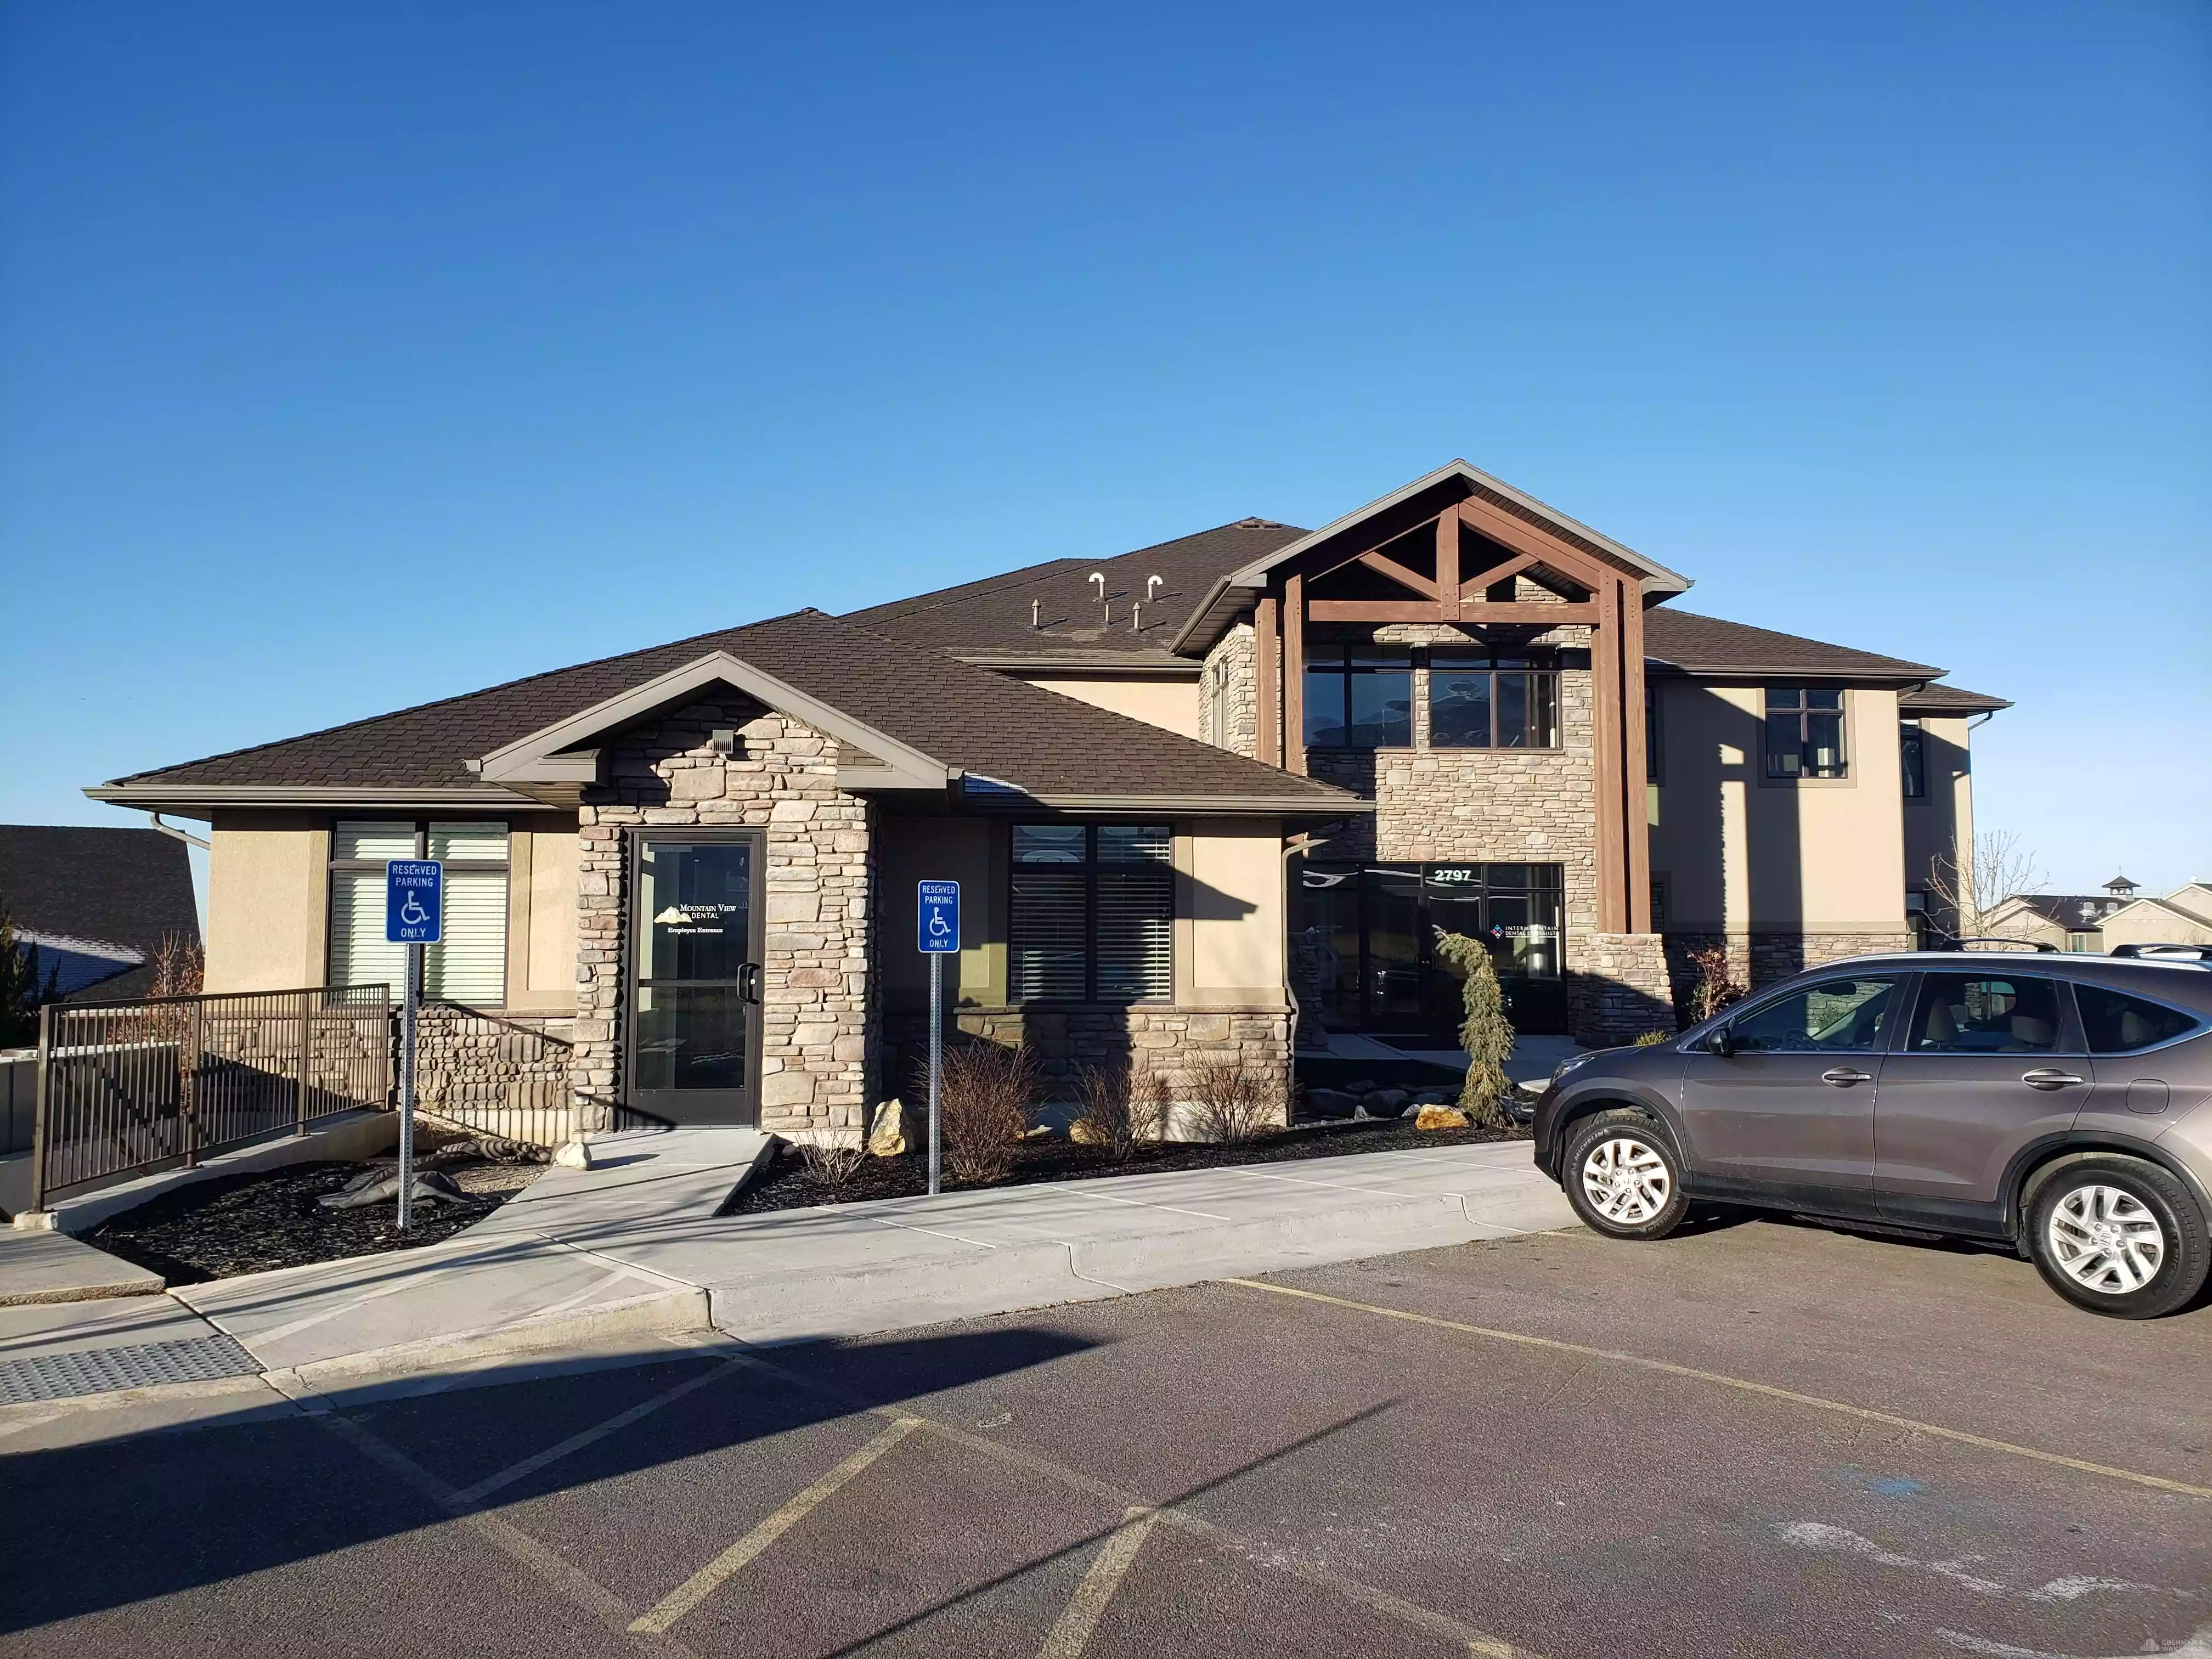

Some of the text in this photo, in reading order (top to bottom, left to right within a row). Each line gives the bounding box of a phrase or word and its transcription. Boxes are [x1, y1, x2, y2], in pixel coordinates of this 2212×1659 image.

[392, 865, 437, 875] RESERVED
[1435, 870, 1471, 881] 2797
[396, 877, 433, 887] PARKING
[922, 885, 956, 894] RESERVED
[924, 896, 953, 904] PARKING
[400, 928, 426, 938] ONLY
[929, 939, 949, 948] ONLY
[1574, 1130, 1604, 1161] MICHELIN
